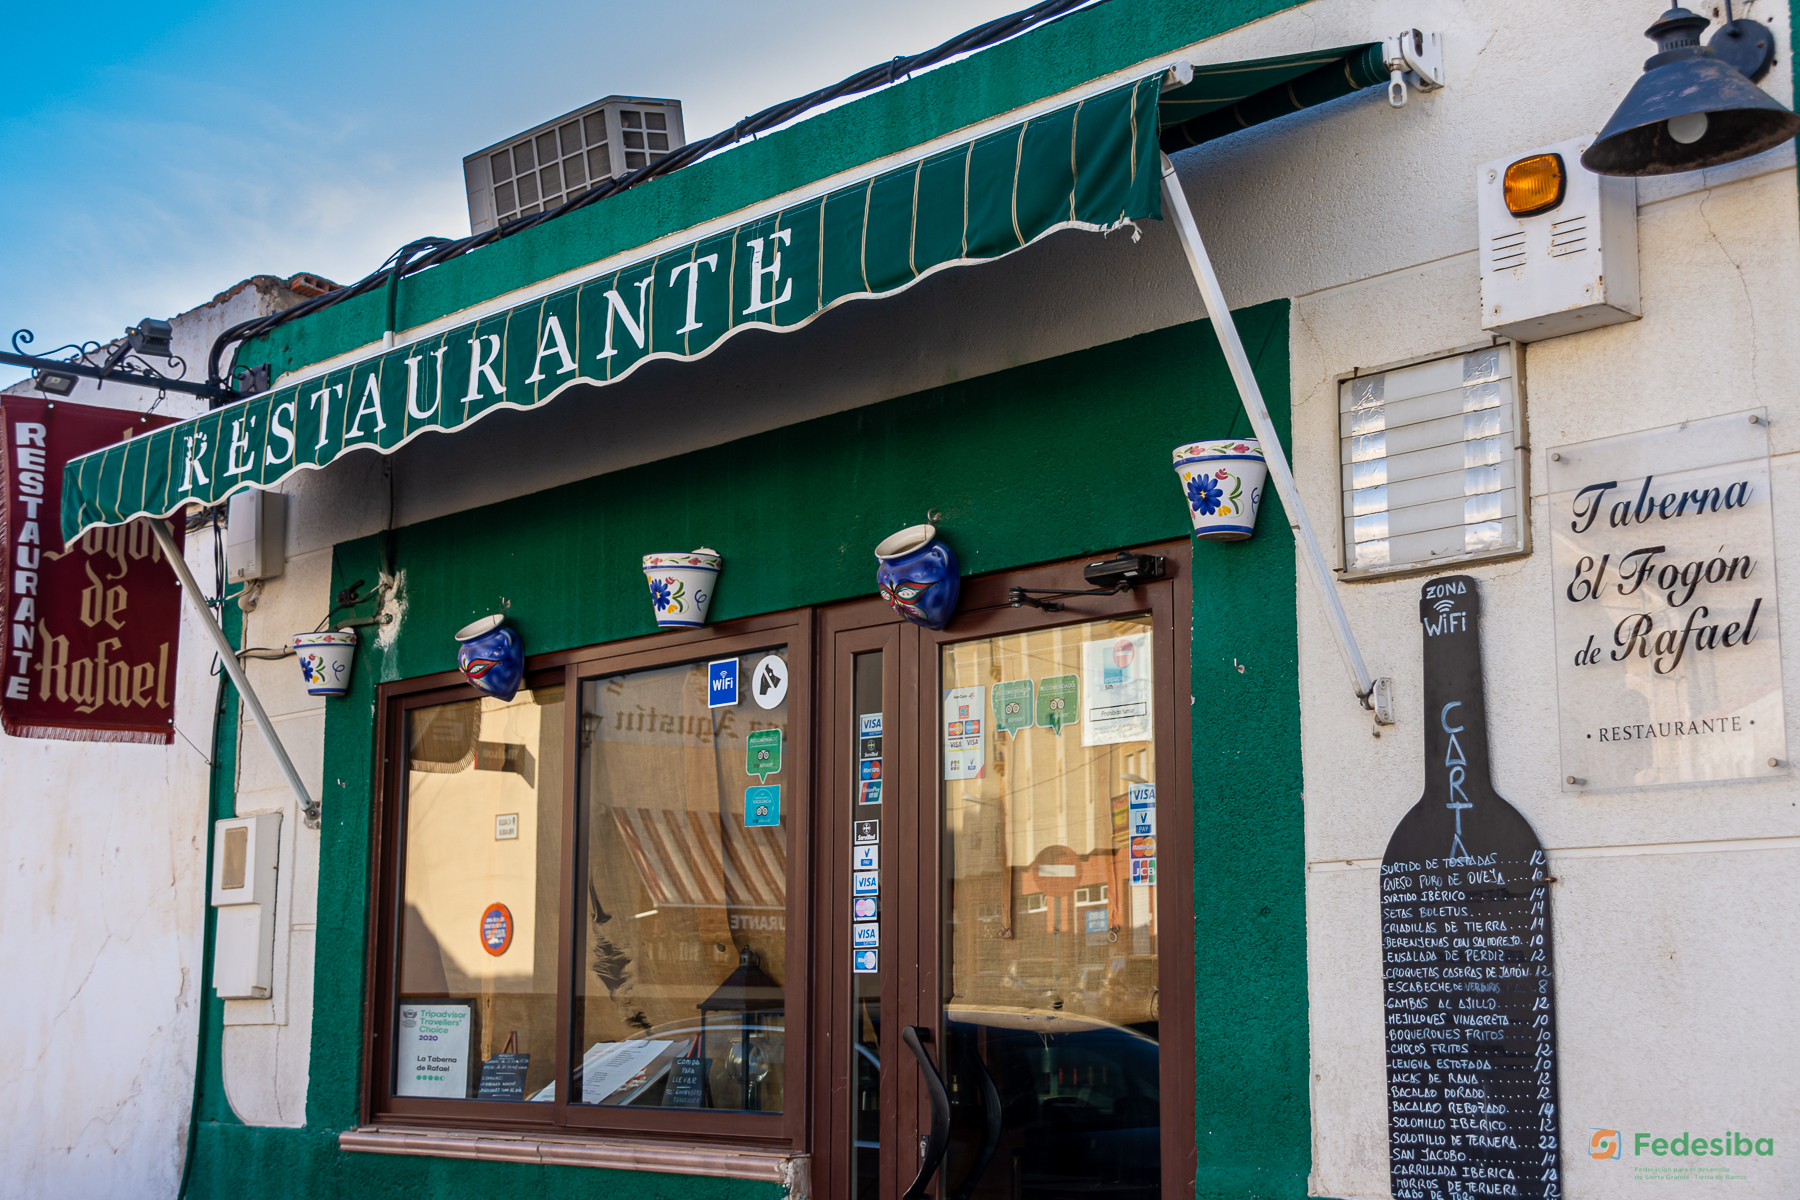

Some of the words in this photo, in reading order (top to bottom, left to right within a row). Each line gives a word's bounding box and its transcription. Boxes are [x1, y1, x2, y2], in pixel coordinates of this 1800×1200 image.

[177, 228, 793, 492] RESTAURANTE
[1571, 475, 1754, 534] Taberna
[6, 422, 47, 700] RESTAURANTE
[1566, 554, 1611, 602] El
[1617, 545, 1758, 608] Fogón
[80, 560, 129, 630] de
[1426, 581, 1467, 599] ZONA
[1574, 635, 1602, 666] de
[1610, 598, 1763, 674] Rafael
[33, 618, 171, 714] Rafael
[863, 718, 882, 729] VISA
[1598, 716, 1742, 742] RESTAURANTE
[1441, 701, 1473, 863] CARTA
[1133, 788, 1156, 801] VISA
[1381, 862, 1421, 875] SURTIDO
[1426, 859, 1439, 869] DE
[1442, 853, 1498, 867] TOSTADAS
[1530, 850, 1545, 865] 12
[1132, 867, 1155, 876] JCB
[858, 877, 877, 887] VISA
[1383, 877, 1412, 891] QUESO
[1420, 876, 1442, 888] PURO
[1448, 874, 1462, 885] DE
[1383, 893, 1416, 903] SURTIDO
[1530, 888, 1545, 901] 14
[1384, 908, 1413, 919] SETAS
[1420, 907, 1468, 917] BOLETUS
[1531, 901, 1544, 914] 14
[1383, 922, 1436, 933] CRIADILLAS
[1445, 922, 1457, 932] DE
[1464, 921, 1507, 931] TIERRA
[1530, 918, 1544, 930] 14
[857, 929, 876, 939] VISA
[1530, 935, 1543, 947] 10
[1387, 951, 1437, 962] ENSALADA
[1445, 951, 1459, 961] DE
[1465, 950, 1504, 962] PERDIZ
[1531, 950, 1545, 962] 12
[1386, 967, 1439, 978] CROQUETAS
[1443, 967, 1482, 978] CASERAS
[1486, 968, 1498, 977] DE
[1536, 966, 1551, 977] 12
[1388, 982, 1452, 992] ESCABECHE
[1453, 983, 1463, 991] DE
[1538, 980, 1548, 993] 8
[1387, 998, 1428, 1009] GAMBAS
[1438, 999, 1452, 1008] AL
[1533, 997, 1549, 1012] 12
[420, 1010, 466, 1018] Tripadvisor
[1453, 1014, 1509, 1025] VINAGRETA
[1533, 1014, 1548, 1028] 10
[1389, 1029, 1460, 1040] BOQUERONES
[1465, 1029, 1504, 1040] FRITOS
[1536, 1028, 1550, 1042] 10
[1390, 1044, 1426, 1054] CHOCOS
[1431, 1044, 1468, 1053] FRITOS
[1535, 1044, 1552, 1057] 12
[1392, 1059, 1431, 1069] LENGUA
[1436, 1059, 1491, 1070] ESTOFADA
[1534, 1059, 1551, 1072] 10
[1392, 1074, 1421, 1083] ANCAS
[1429, 1074, 1441, 1084] DE
[1449, 1073, 1478, 1084] RANA
[1537, 1072, 1551, 1085] 12
[1391, 1086, 1437, 1098] BACALAO
[1445, 1086, 1484, 1098] DORADO
[1537, 1087, 1551, 1099] 12
[1392, 1101, 1441, 1113] BACALAO
[1449, 1102, 1506, 1114] REBOZADO
[1393, 1117, 1445, 1129] SOLOMILLO
[1540, 1118, 1555, 1131] 12
[1393, 1132, 1445, 1145] SOLOMILLO
[1451, 1135, 1462, 1145] DE
[1466, 1134, 1517, 1148] TERNERA
[1538, 1135, 1556, 1149] 22
[1393, 1149, 1414, 1160] SAN
[1420, 1150, 1465, 1161] JACOBO
[1541, 1152, 1555, 1165] 14
[1394, 1165, 1456, 1176] CARRILLADA
[1397, 1178, 1438, 1189] MORROS
[1448, 1181, 1462, 1193] DE
[1466, 1182, 1518, 1196] TERNERA
[1543, 1183, 1561, 1197] 12
